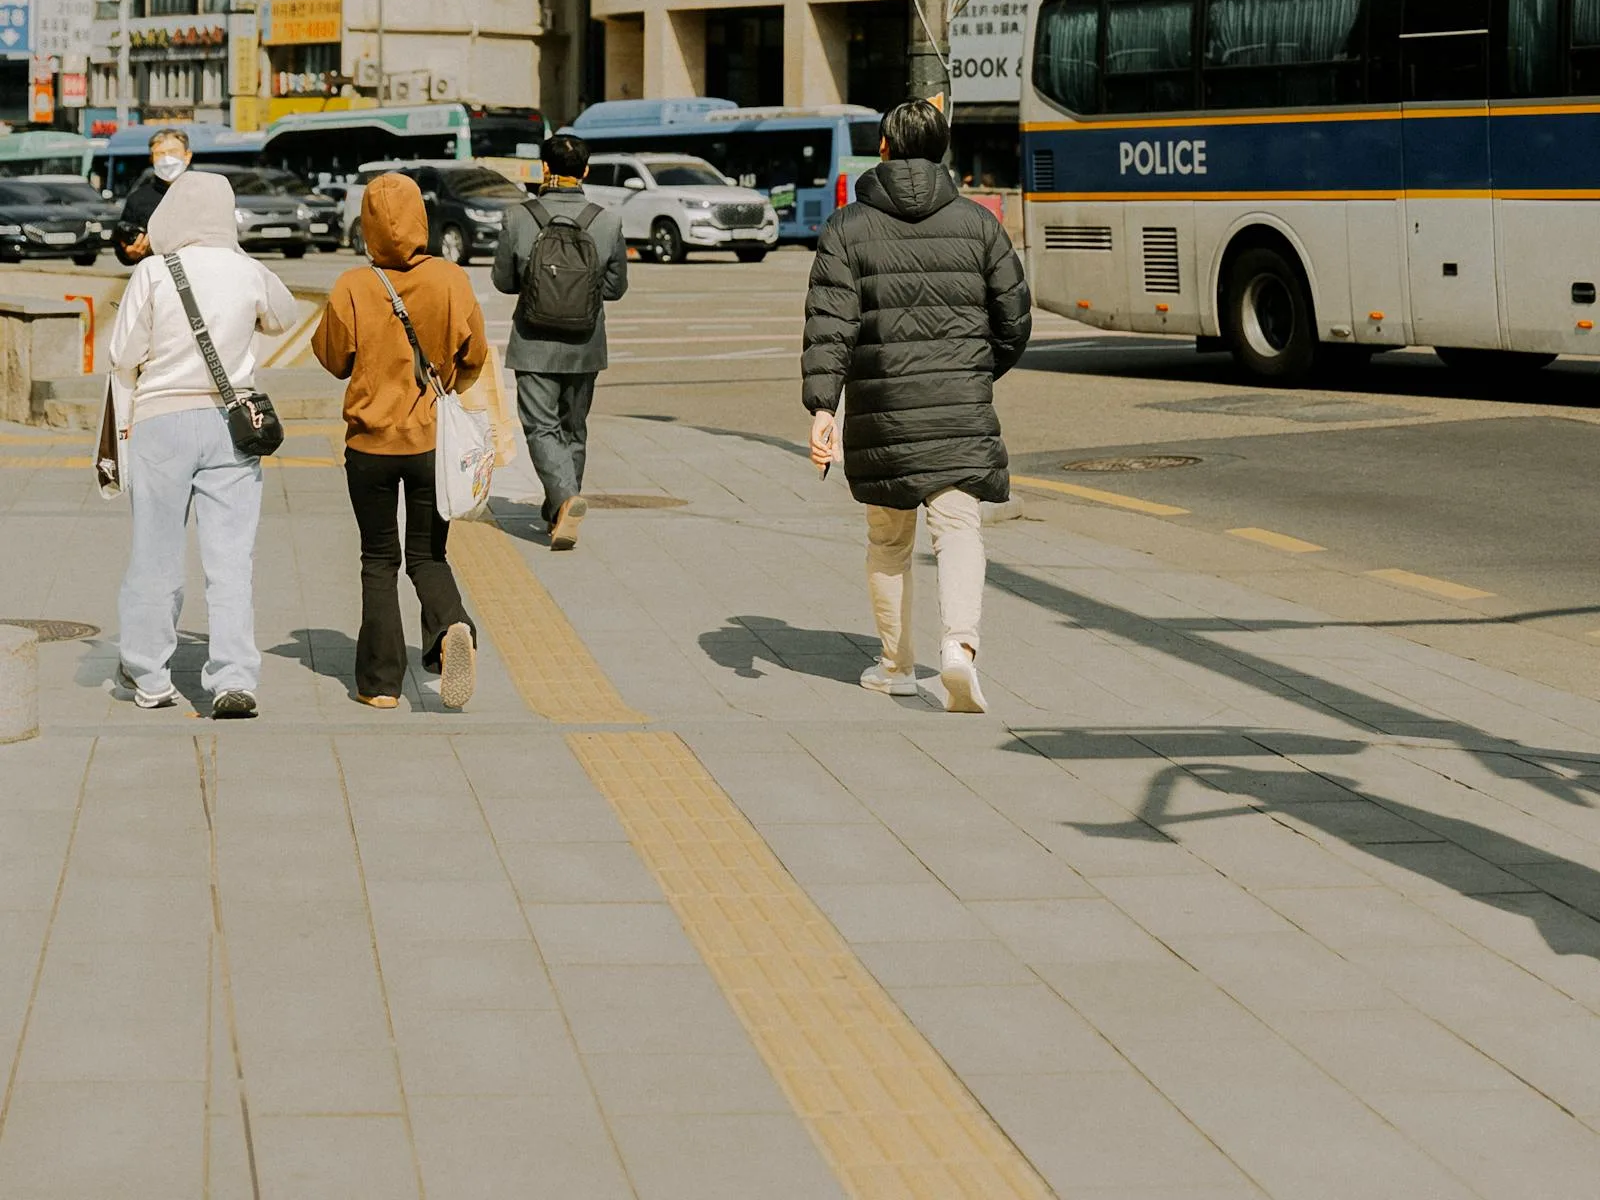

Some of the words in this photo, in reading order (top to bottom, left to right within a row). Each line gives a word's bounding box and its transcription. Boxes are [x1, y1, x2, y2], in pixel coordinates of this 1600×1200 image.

[952, 56, 1008, 78] BOOK
[1118, 139, 1208, 175] POLICE
[197, 336, 234, 400] BURBERRY
